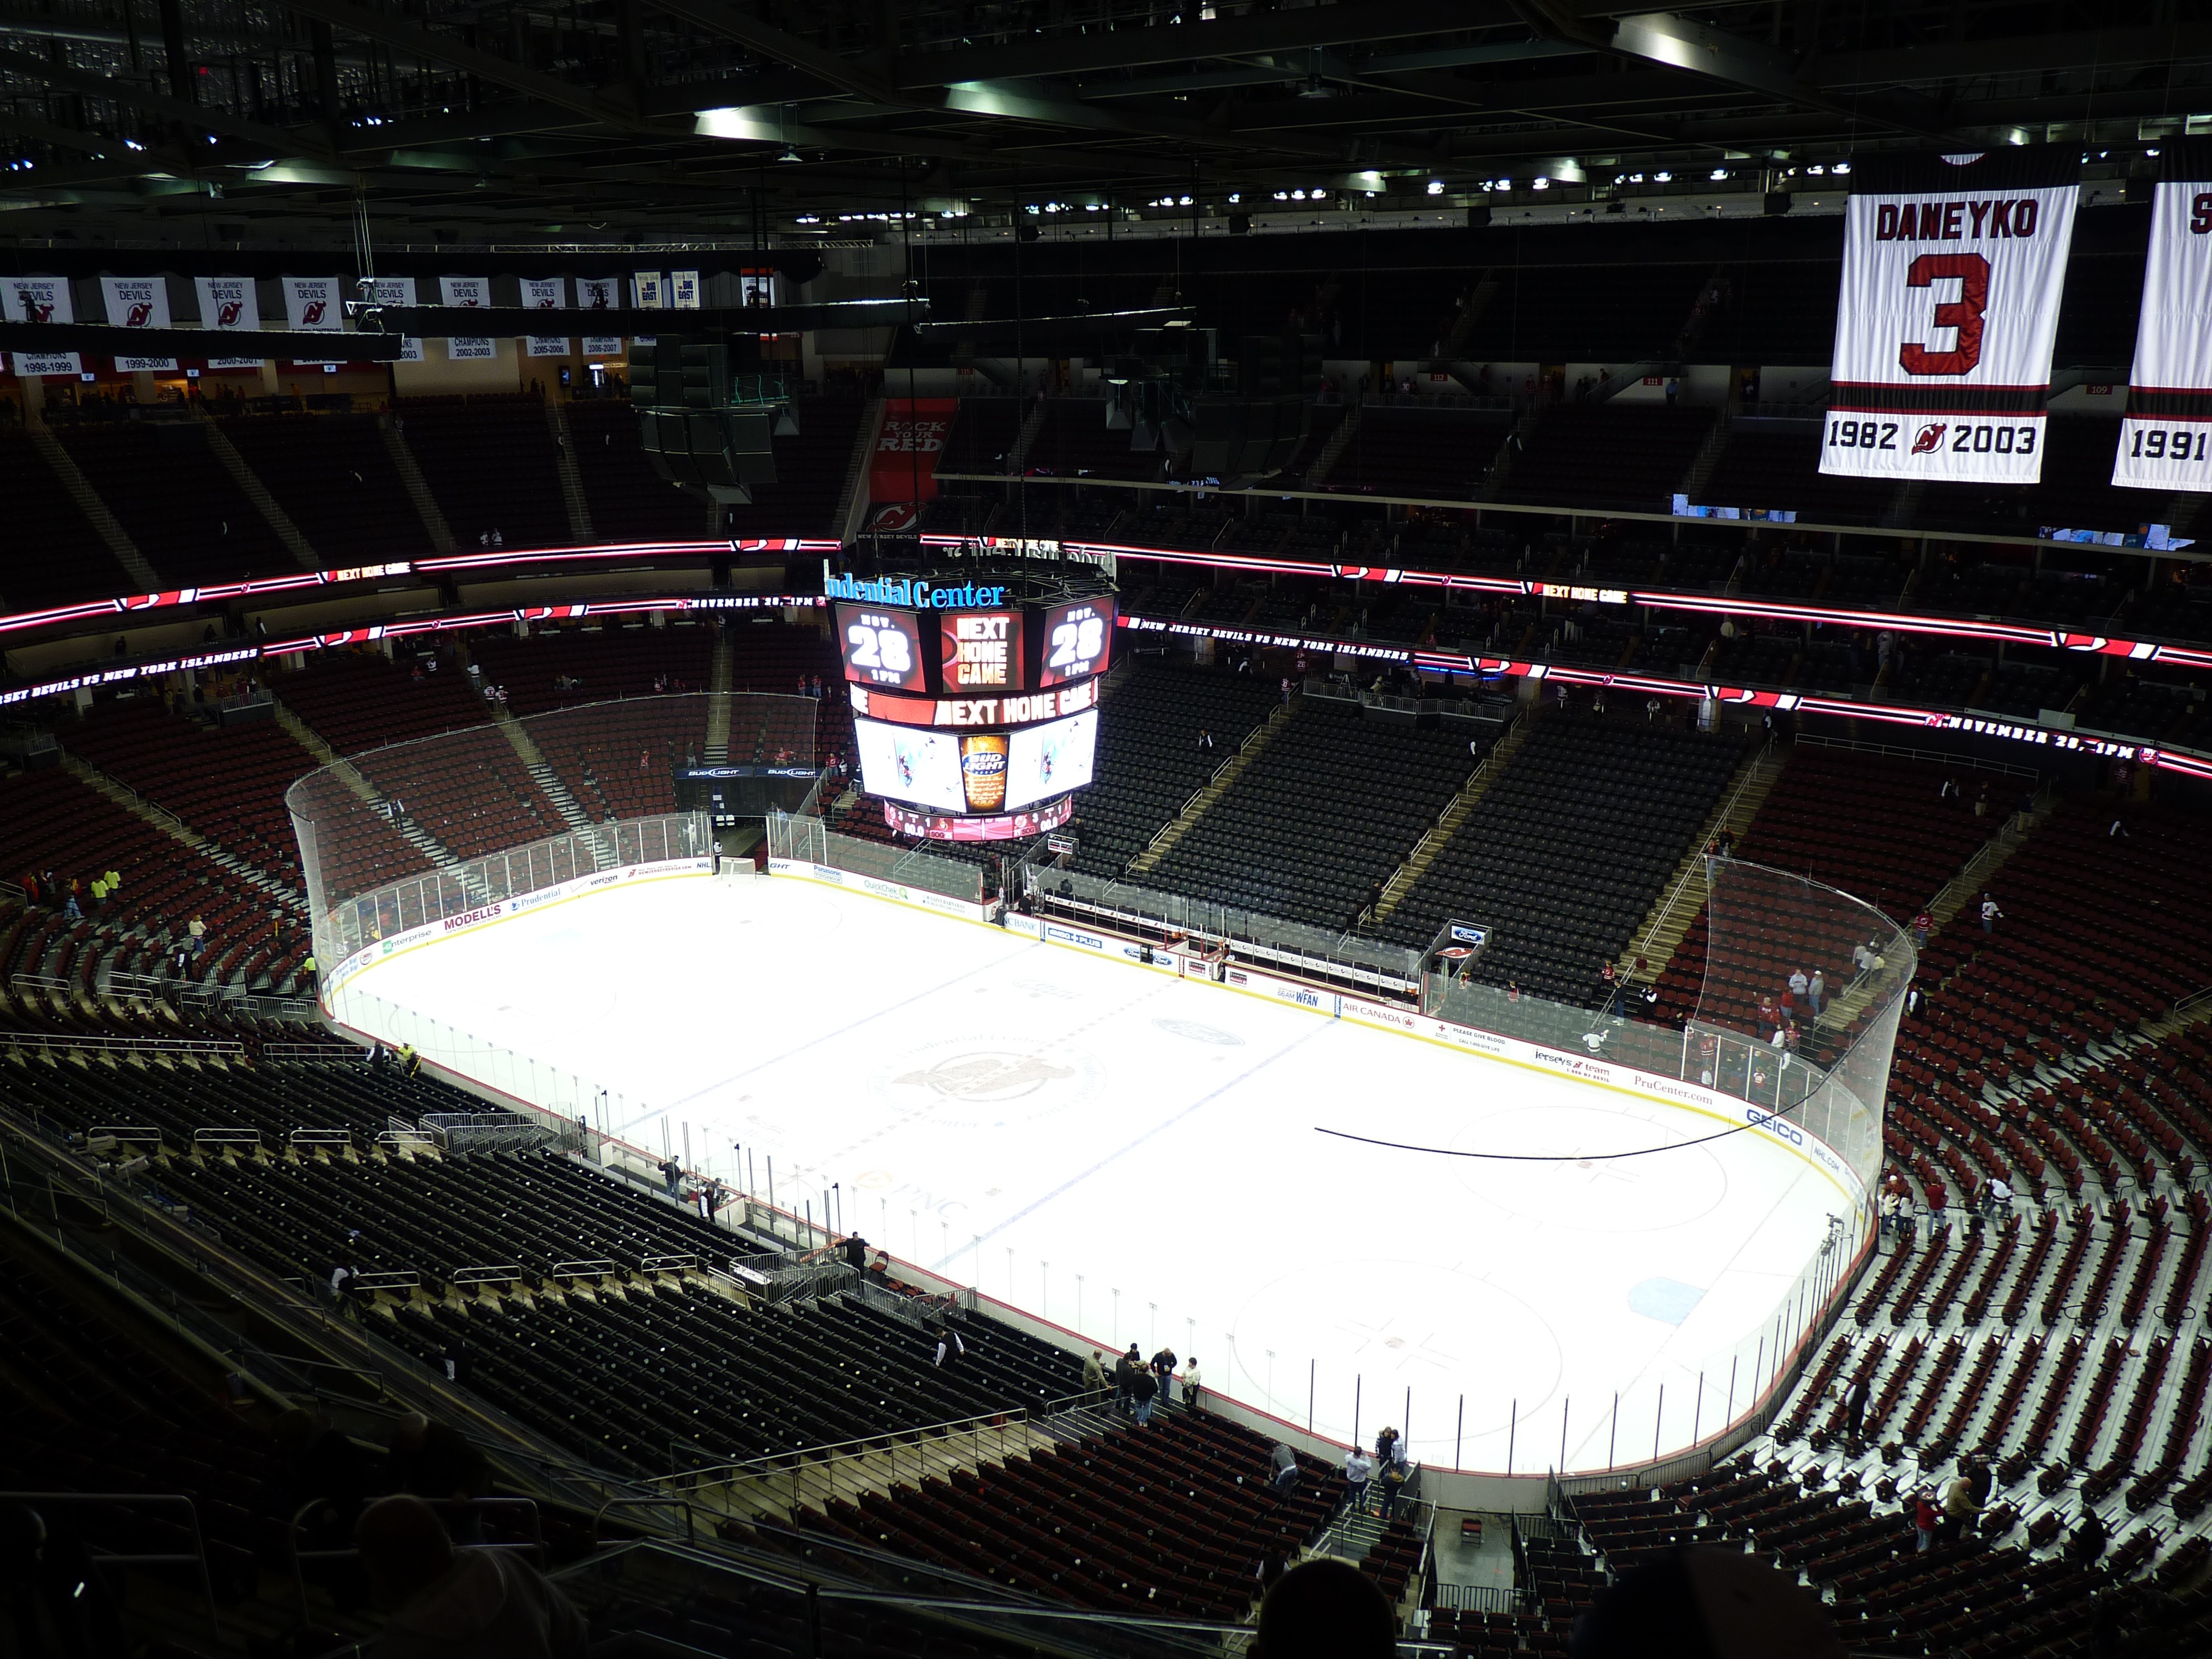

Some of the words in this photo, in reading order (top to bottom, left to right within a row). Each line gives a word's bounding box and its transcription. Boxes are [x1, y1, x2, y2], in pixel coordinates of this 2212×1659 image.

[1876, 199, 2038, 241] DANEYKO
[646, 282, 656, 291] BIG
[683, 280, 693, 290] BIG
[119, 291, 152, 300] DEVILS
[212, 290, 242, 299] DEVILS
[298, 290, 326, 299] DEVILS
[378, 290, 403, 298] DEVILS
[454, 289, 478, 297] DEVILS
[642, 291, 656, 300] EAST
[678, 291, 693, 300] EAST
[1899, 253, 1990, 375] 3
[455, 337, 489, 347] CHAMPIONS
[456, 348, 491, 357] 2002-2003
[534, 345, 564, 353] 2005-2006
[24, 362, 72, 372] 1998-1999
[125, 359, 169, 369] 1999-2000
[2091, 385, 2108, 394] 109
[1829, 421, 1898, 450] 1982
[1953, 425, 2036, 455] 2003
[877, 438, 943, 452] RED
[2131, 430, 2204, 461] 1991
[913, 581, 1004, 608] Center
[1543, 584, 1571, 599] NEXT
[1571, 587, 1598, 601] HOME
[692, 598, 758, 608] NOVEMBER
[791, 597, 813, 606] 1PM
[1067, 607, 1095, 622] NOV.
[861, 614, 895, 629] NOV.
[957, 617, 1010, 639] NEXT
[1050, 618, 1103, 667] 28
[1142, 621, 1166, 630] NEW
[1170, 624, 1211, 636] JERSEY
[1212, 630, 1253, 641] DEVILS
[1256, 635, 1270, 644] VS
[1274, 637, 1300, 648] NEW
[1303, 640, 1334, 651] YORK
[1337, 644, 1409, 661] ISLANDERS
[848, 625, 911, 672] 28
[957, 641, 1007, 663] HOME
[32, 679, 79, 697] DEVILS
[83, 675, 100, 685] VS
[103, 668, 137, 681] NEW
[141, 662, 177, 675] YORK
[180, 649, 257, 668] ISLANDERS
[957, 664, 1006, 684] GAME
[936, 700, 998, 725] NEXT
[1004, 693, 1055, 723] HOME
[1949, 717, 2048, 744] NOVEMBER
[2054, 734, 2086, 752] 28,
[2095, 741, 2135, 759] 1PM
[971, 754, 1001, 763] BUD
[964, 761, 1005, 770] LIGHT
[898, 811, 903, 821] 3
[1058, 805, 1061, 814] 1
[925, 817, 930, 827] 1
[1032, 813, 1038, 823] 3
[813, 865, 842, 877] Panasonic
[590, 875, 618, 885] verizon
[864, 880, 897, 894] QuickChek
[521, 888, 561, 907] Prudential
[444, 905, 501, 930] MODELL'S
[1015, 918, 1037, 931] BANK
[384, 929, 432, 949] enterprise
[1459, 930, 1478, 940] Ford
[1078, 936, 1101, 948] PLUS
[1128, 948, 1140, 958] Ford
[1154, 955, 1168, 964] Ford
[1296, 988, 1318, 1006] WFAN
[1343, 1003, 1358, 1013] AIR
[1360, 1008, 1400, 1024] CANADA
[1453, 1028, 1473, 1037] PLEASE
[1487, 1035, 1506, 1045] BLOOD.
[1535, 1049, 1572, 1067] jersey's
[1585, 1063, 1610, 1075] team
[1634, 1076, 1713, 1105] PruCenter.com
[1746, 1109, 1803, 1146] GEICO
[1814, 1146, 1840, 1172] NHL.COM
